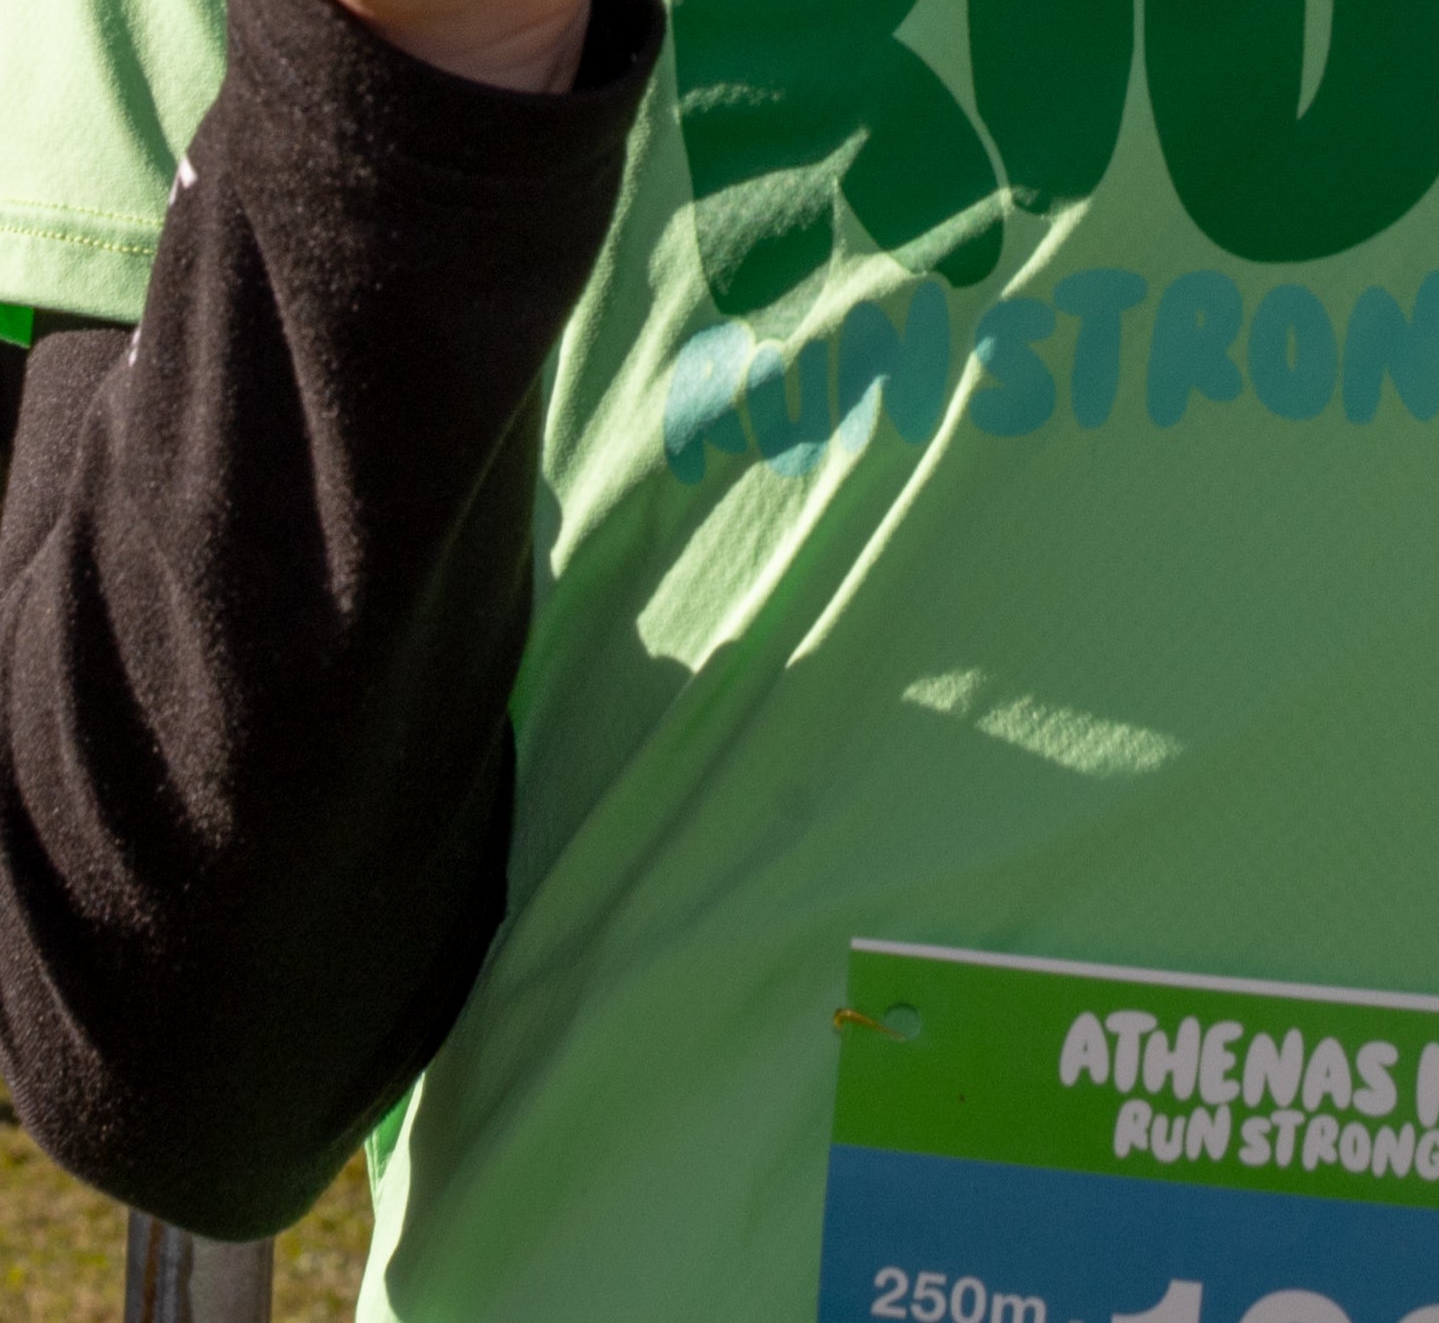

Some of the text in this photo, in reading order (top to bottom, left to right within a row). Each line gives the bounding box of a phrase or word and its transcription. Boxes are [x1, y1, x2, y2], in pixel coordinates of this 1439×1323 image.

[664, 276, 951, 484] RUN
[1060, 1010, 1398, 1117] ATHENAS
[1114, 1099, 1231, 1163] RUN
[870, 1265, 1047, 1323] 250m
